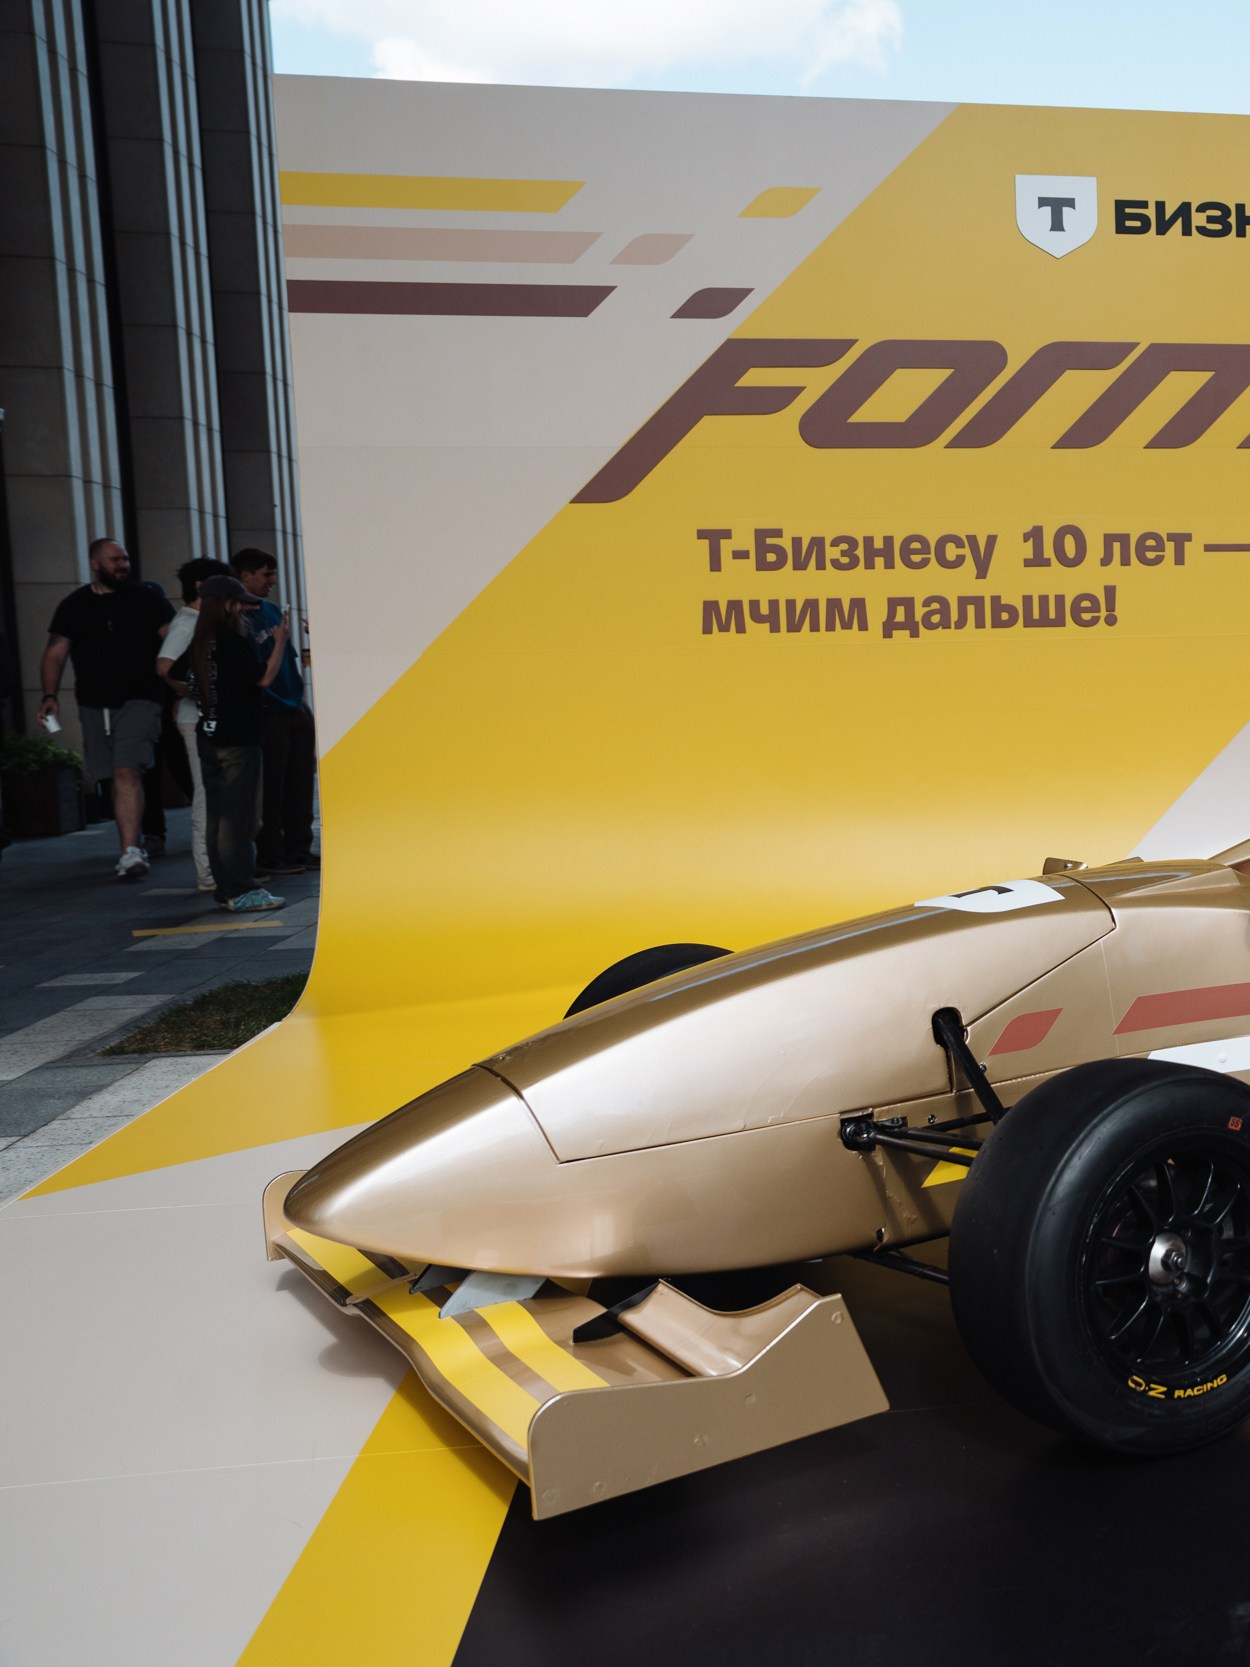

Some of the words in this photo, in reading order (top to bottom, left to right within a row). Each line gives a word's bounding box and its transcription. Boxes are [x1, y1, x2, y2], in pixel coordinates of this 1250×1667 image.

[696, 528, 998, 579] Т-Бизнесу
[1022, 524, 1087, 568] 10
[1100, 532, 1193, 566] лет
[701, 597, 869, 635] мчим
[882, 585, 1118, 638] дальше!
[1174, 1374, 1228, 1398] RACING
